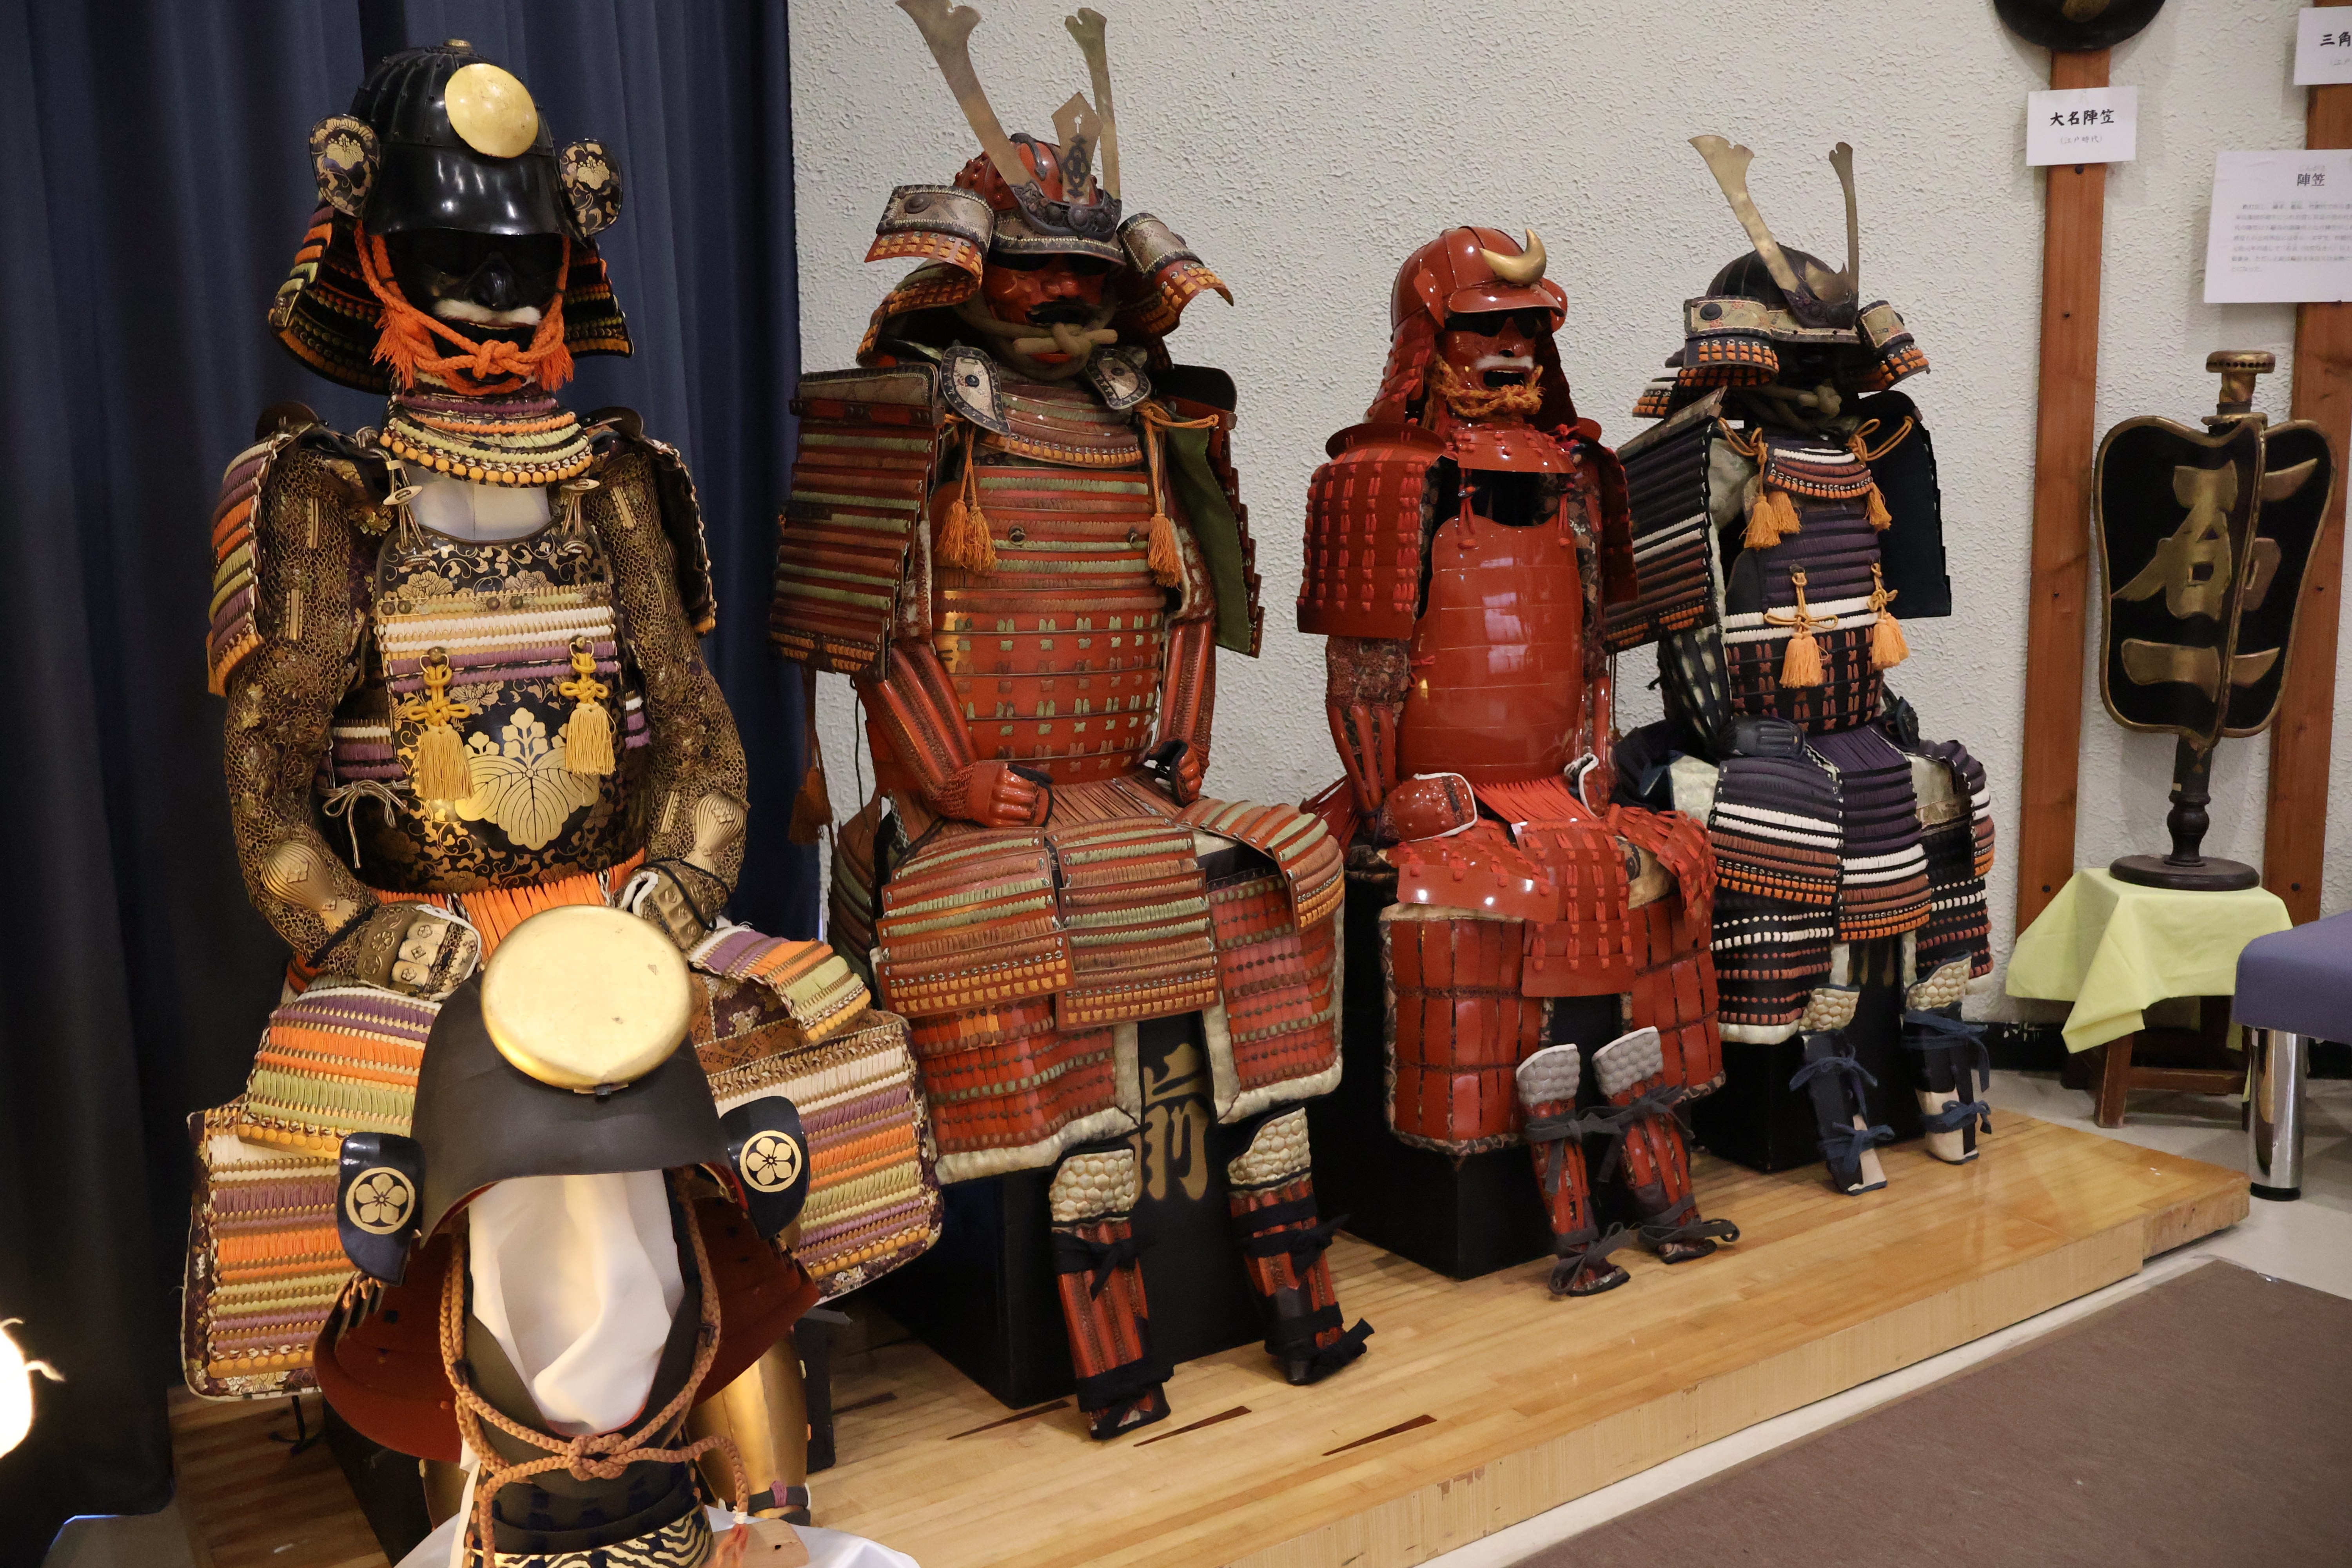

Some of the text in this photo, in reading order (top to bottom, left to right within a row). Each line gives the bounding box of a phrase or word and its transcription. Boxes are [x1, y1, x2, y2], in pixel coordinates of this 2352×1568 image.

[2320, 31, 2351, 47] 三角
[2050, 109, 2114, 126] 大名陣笠
[2297, 173, 2325, 186] 陣笠
